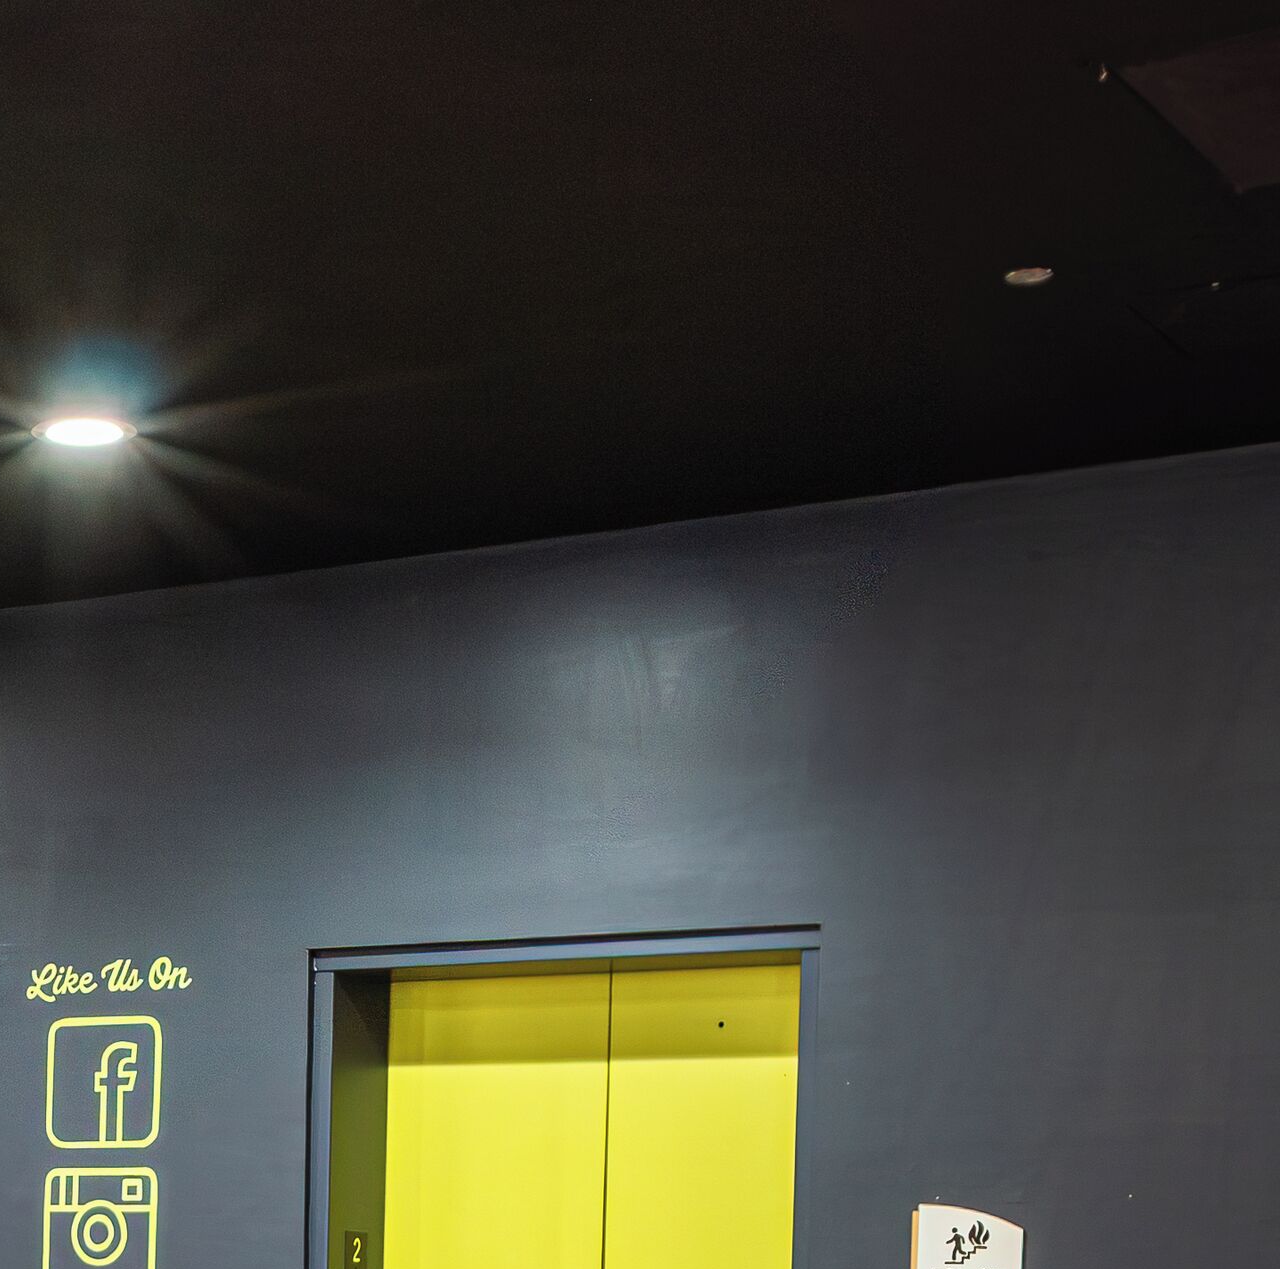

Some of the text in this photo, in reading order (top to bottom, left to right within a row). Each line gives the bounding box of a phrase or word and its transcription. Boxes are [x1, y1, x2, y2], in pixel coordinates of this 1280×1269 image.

[26, 956, 193, 1003] Like Us On
[352, 1236, 362, 1264] 2
